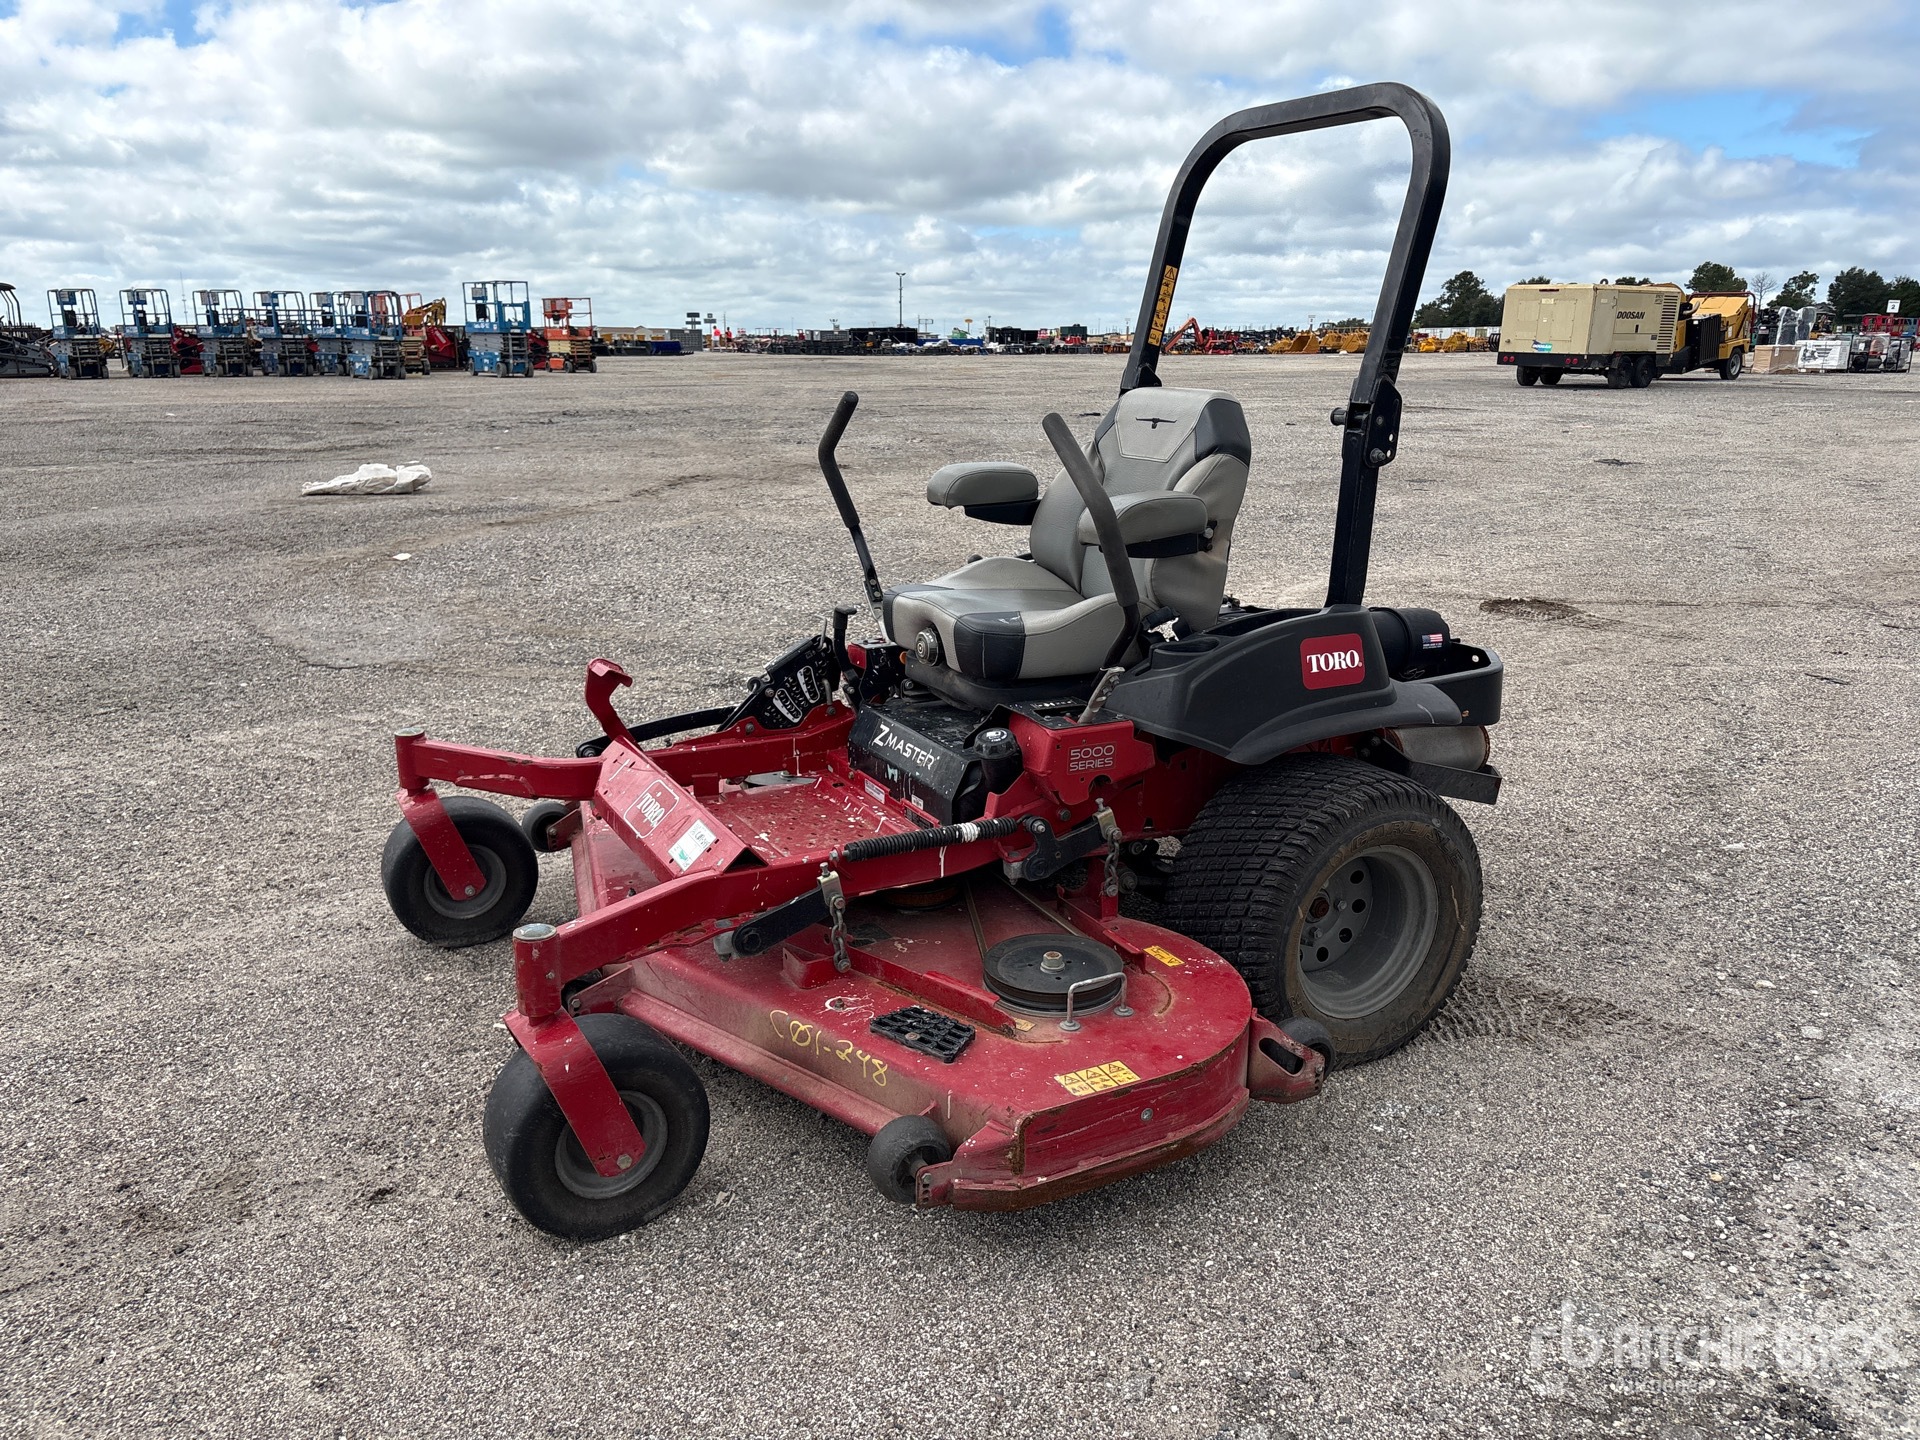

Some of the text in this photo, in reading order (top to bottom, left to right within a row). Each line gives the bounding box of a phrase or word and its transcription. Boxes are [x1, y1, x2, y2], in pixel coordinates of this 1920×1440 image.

[1616, 311, 1646, 320] DOOSAN
[1306, 649, 1361, 674] TORO
[1070, 745, 1115, 761] 5000
[1069, 757, 1114, 772] SERIES
[635, 792, 665, 826] TORO
[1351, 821, 1464, 867] CARLISLE
